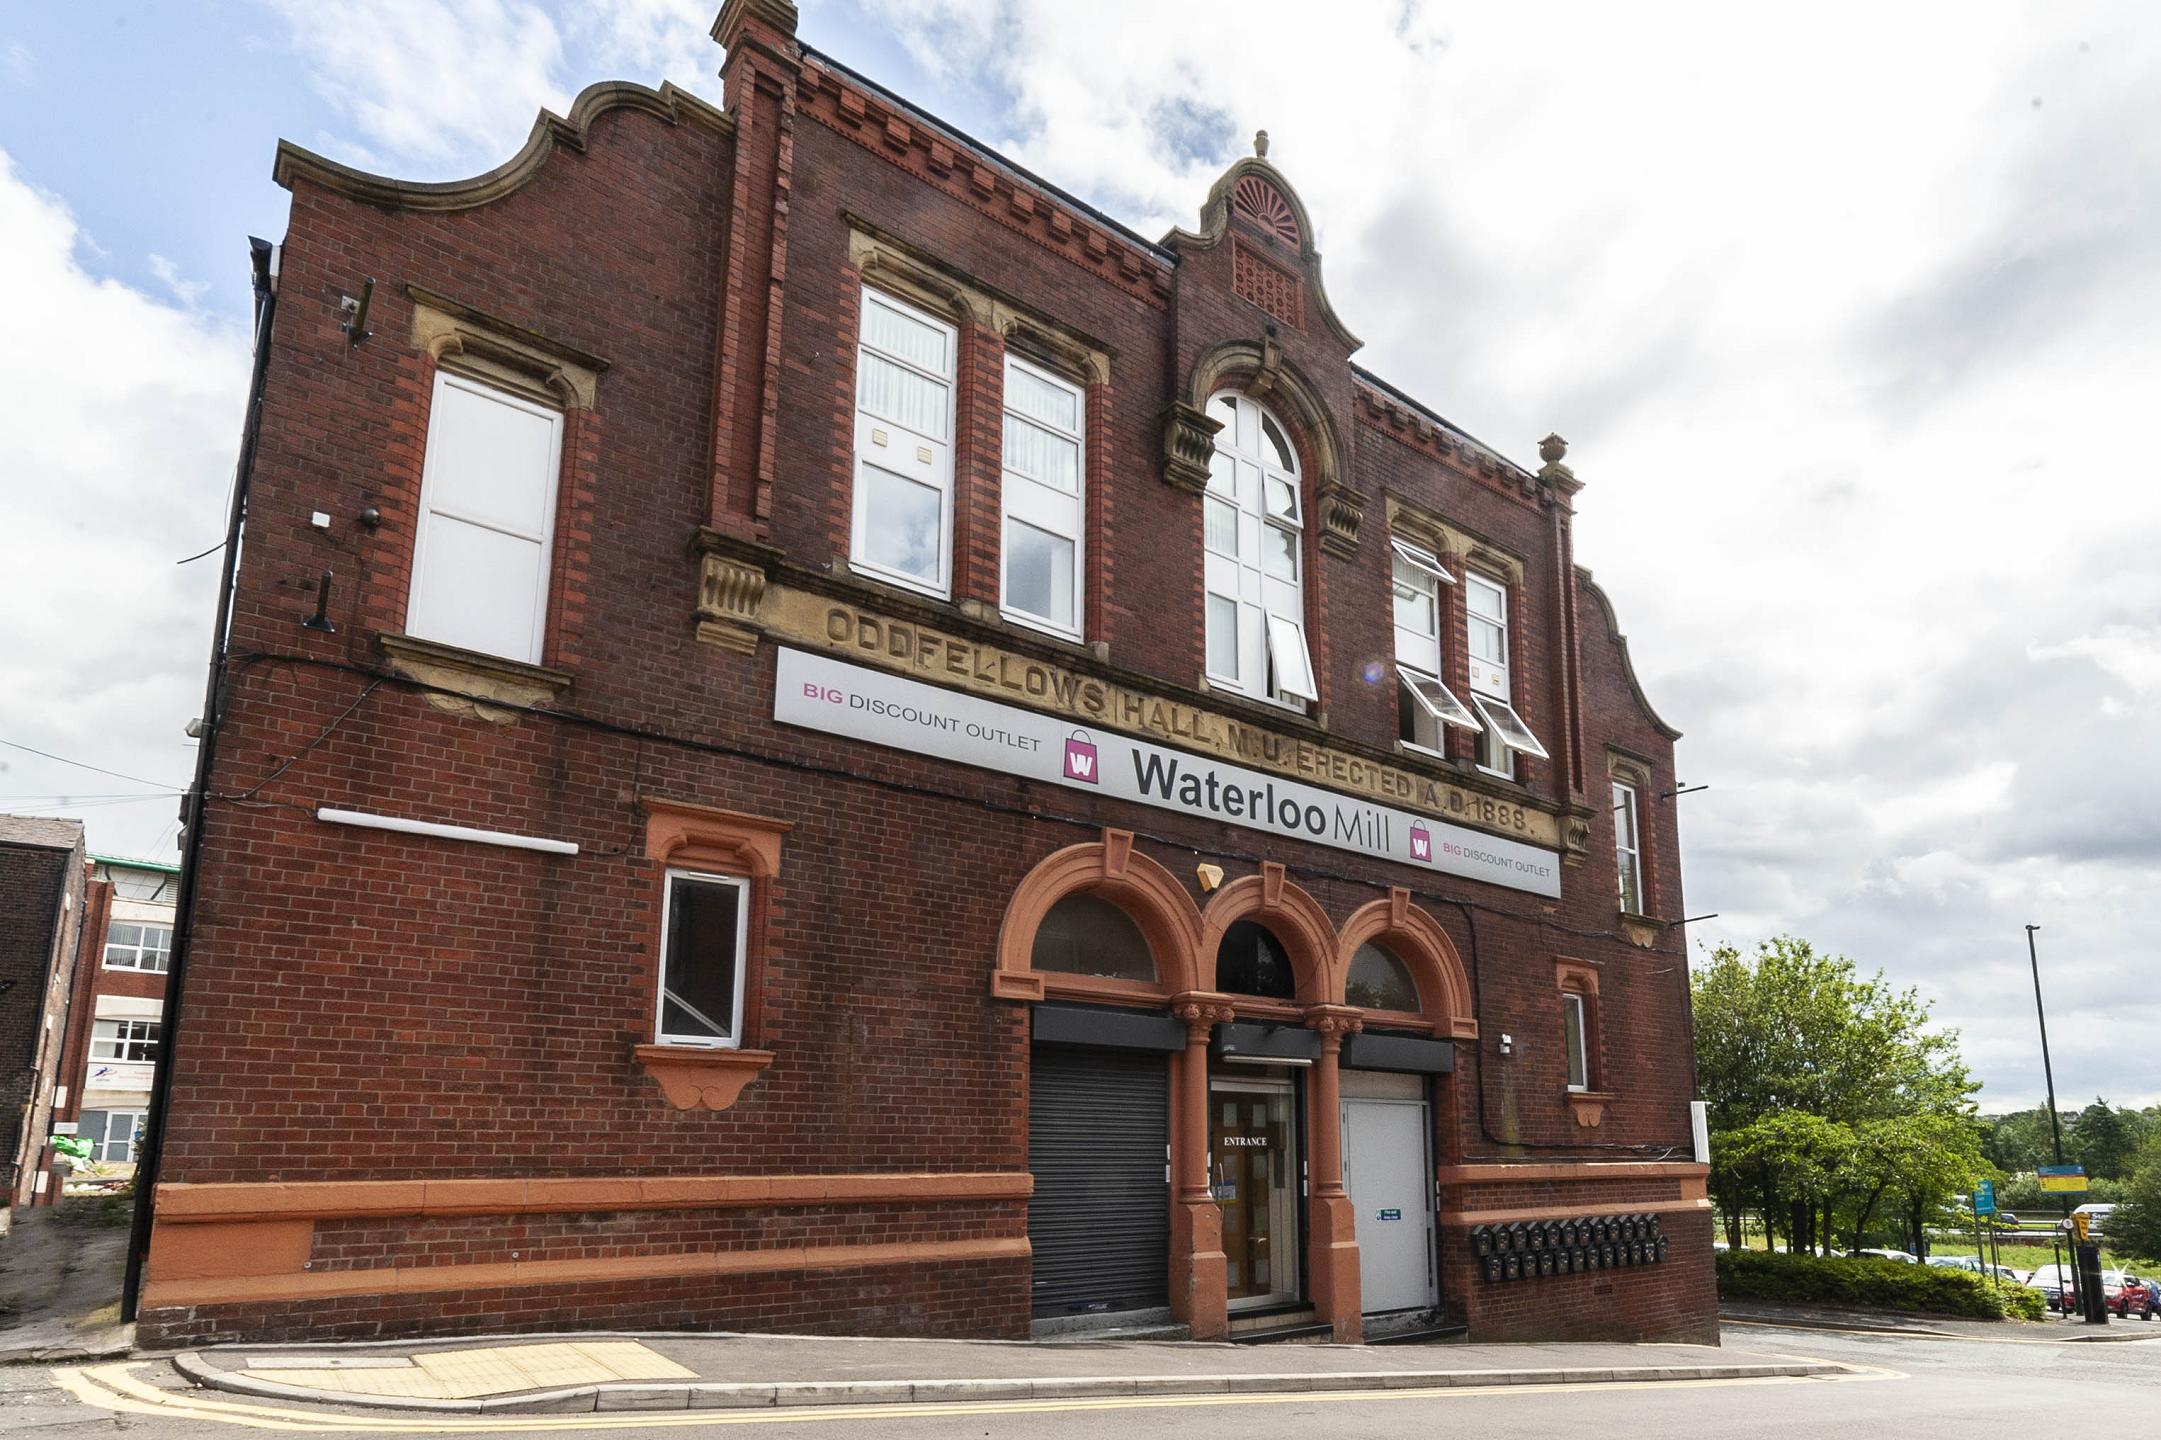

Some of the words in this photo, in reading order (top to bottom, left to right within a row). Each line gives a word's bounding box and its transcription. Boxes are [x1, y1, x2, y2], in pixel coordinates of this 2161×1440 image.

[803, 682, 844, 705] BIG
[849, 694, 960, 732] DISCOUNT
[966, 723, 1041, 752] OUTLET
[1070, 752, 1093, 777] W
[1299, 745, 1411, 798] ERECTED
[1131, 748, 1326, 835] Waterloo
[1334, 803, 1390, 853] Mill
[1413, 838, 1428, 857] W
[1443, 842, 1462, 856] BIG
[1463, 847, 1513, 870] DISCOUNT
[1515, 861, 1551, 878] OUTLET
[1224, 1136, 1267, 1147] ENTRANCE
